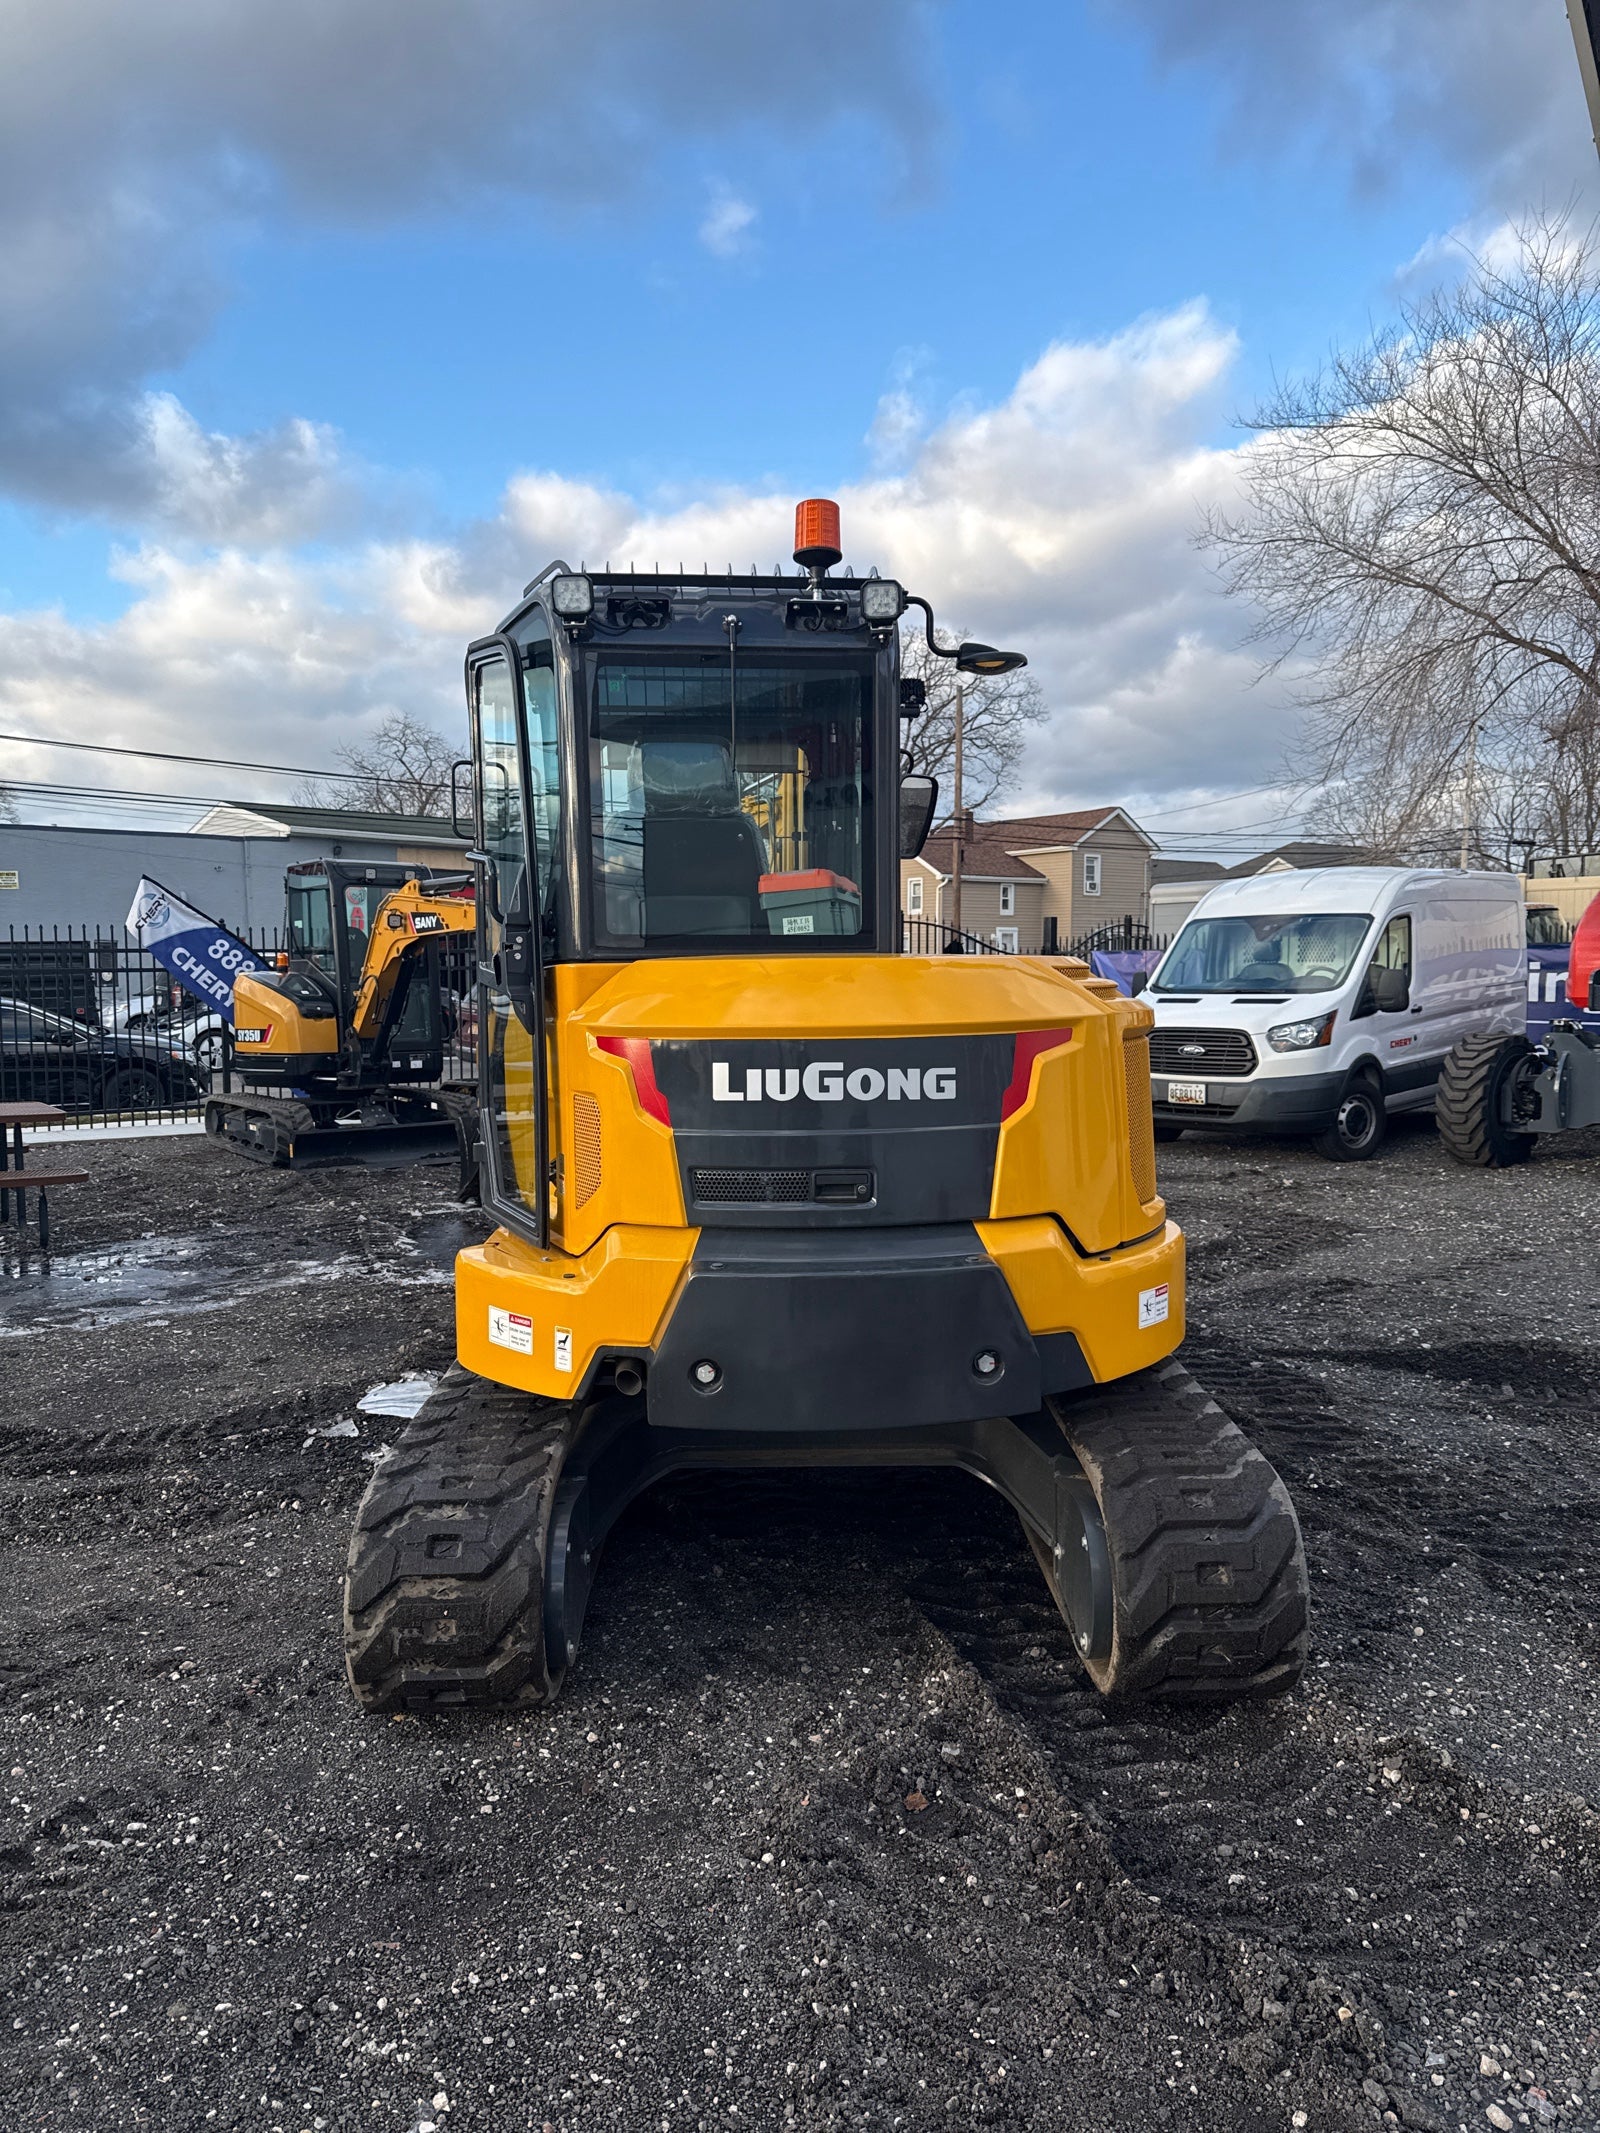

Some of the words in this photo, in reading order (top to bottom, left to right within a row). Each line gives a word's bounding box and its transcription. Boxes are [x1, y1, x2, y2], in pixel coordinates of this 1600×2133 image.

[135, 893, 166, 929] CHERY
[415, 916, 437, 929] SANY
[237, 1029, 261, 1042] SY35U
